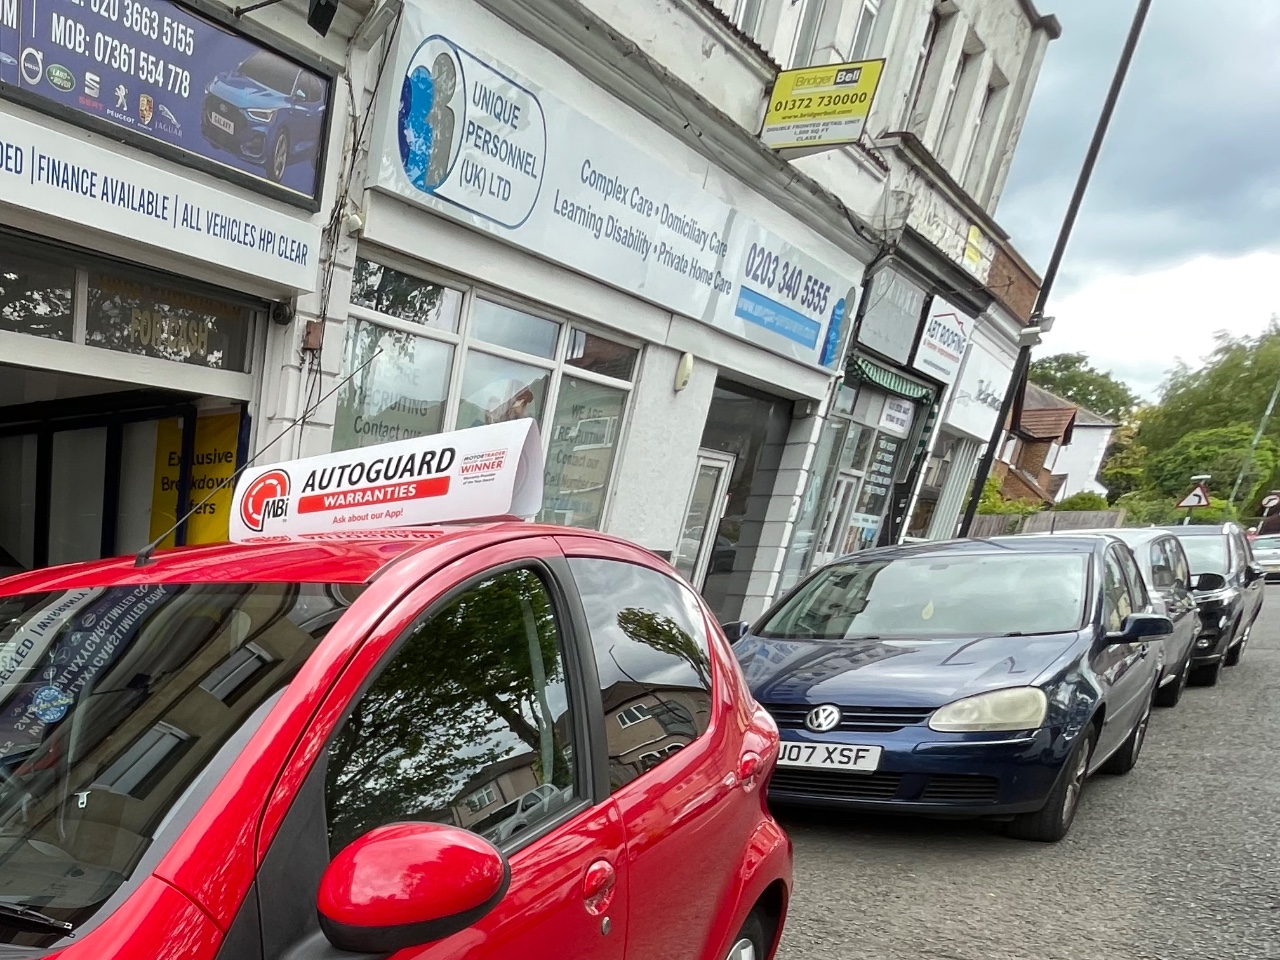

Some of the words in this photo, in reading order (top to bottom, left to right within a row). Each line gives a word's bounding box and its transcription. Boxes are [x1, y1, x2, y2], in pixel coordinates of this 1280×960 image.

[123, 1, 159, 40] 3663
[163, 16, 194, 56] 5155
[51, 12, 90, 56] MOB:
[94, 32, 136, 76] 07361
[139, 51, 163, 87] 554
[167, 63, 190, 98] 778
[795, 75, 834, 87] Bridger
[835, 70, 861, 83] Bell
[107, 108, 135, 123] PEUGEOT
[472, 80, 521, 130] UNIQUE
[774, 97, 813, 112] 01372
[816, 92, 868, 108] 730000
[155, 121, 183, 138] JAGUAR
[465, 120, 538, 180] PERSONNEL
[460, 158, 487, 198] (UK)
[489, 172, 511, 202] LTD
[37, 154, 97, 199] FINANCE
[101, 176, 169, 221] AVAILABLE
[181, 203, 202, 232] ALL
[206, 210, 257, 248] VEHICLES
[259, 228, 277, 255] HPI
[279, 235, 308, 266] CLEAR
[581, 159, 629, 206] Complex
[630, 186, 653, 218] Care
[660, 203, 710, 252] Domiciliary
[709, 231, 728, 259] Care
[553, 189, 603, 240] Learning
[604, 215, 652, 262] Disability
[657, 241, 688, 275] Private
[688, 257, 713, 287] Home
[713, 270, 732, 296] Care
[745, 242, 780, 289] 0203
[777, 261, 803, 301] 340
[801, 274, 831, 316] 5555
[130, 308, 163, 347] FOR
[167, 314, 209, 357] CASH
[353, 415, 401, 440] Contact
[168, 448, 234, 467] Exusive
[302, 447, 456, 494] AUTOGUARD
[461, 460, 503, 474] WINNER
[556, 449, 586, 467] Contact
[323, 484, 417, 508] WARRANTIES
[332, 515, 346, 524] Ask
[347, 511, 369, 522] about
[370, 511, 384, 520] our
[385, 508, 403, 521] App!
[821, 746, 870, 766] XSF
